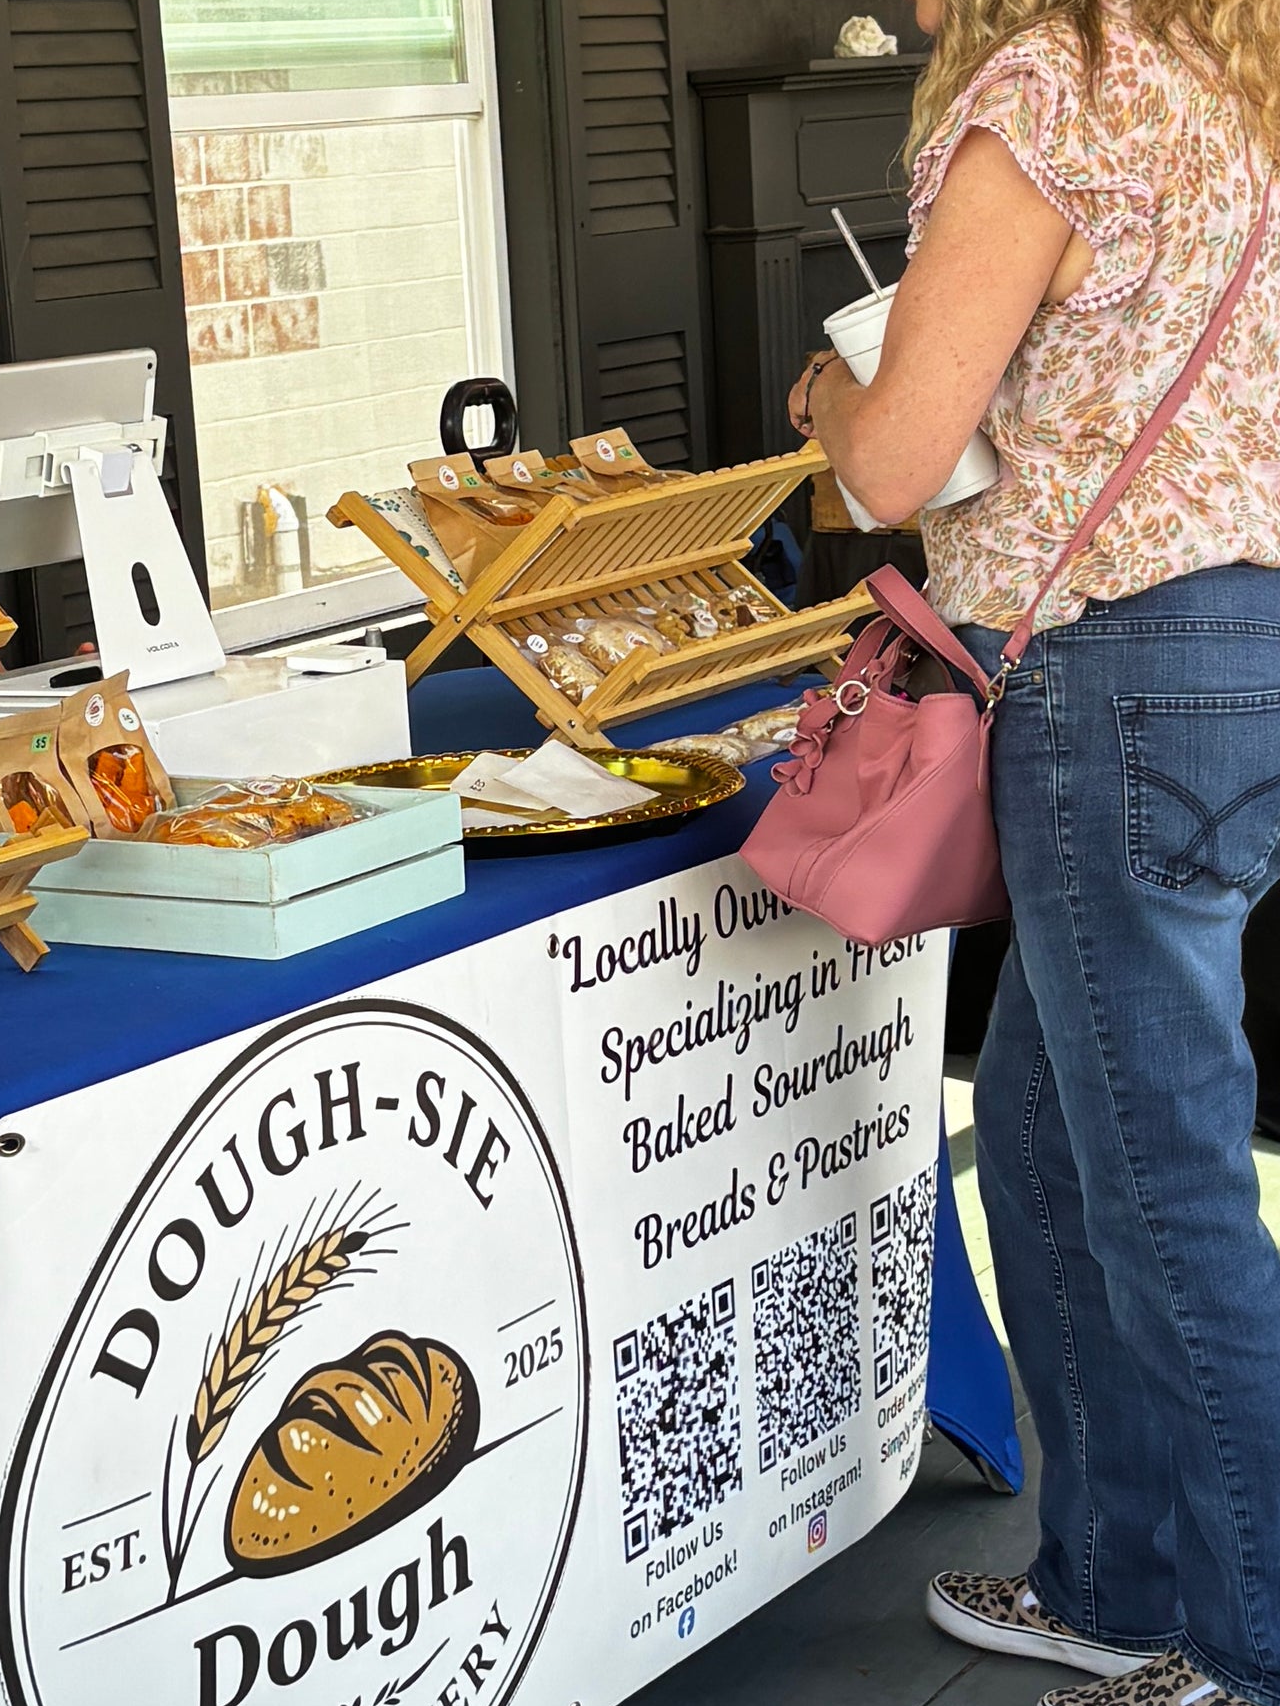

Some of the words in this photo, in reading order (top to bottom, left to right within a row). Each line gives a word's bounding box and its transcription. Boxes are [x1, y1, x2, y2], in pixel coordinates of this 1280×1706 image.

[35, 736, 47, 749] $5
[562, 896, 707, 992] Locally
[601, 969, 807, 1102] Specializing
[811, 951, 841, 999] in
[623, 1074, 737, 1173] Baked
[753, 997, 915, 1118] Sourdough
[634, 1168, 756, 1270] Breads
[767, 1151, 790, 1206] &
[794, 1103, 911, 1190] Pastries
[90, 1061, 511, 1399] DOUGH-SIE
[503, 1327, 565, 1388] 2025
[877, 1395, 906, 1429] Order
[880, 1425, 910, 1463] Simply
[769, 1515, 787, 1538] on
[790, 1458, 862, 1525] Instagram!
[780, 1450, 826, 1491] Follow
[829, 1432, 847, 1459] Us
[61, 1529, 147, 1594] EST.
[645, 1533, 699, 1587] Follow
[703, 1520, 724, 1550] Us
[630, 1614, 651, 1639] on
[656, 1549, 738, 1623] Facebook!
